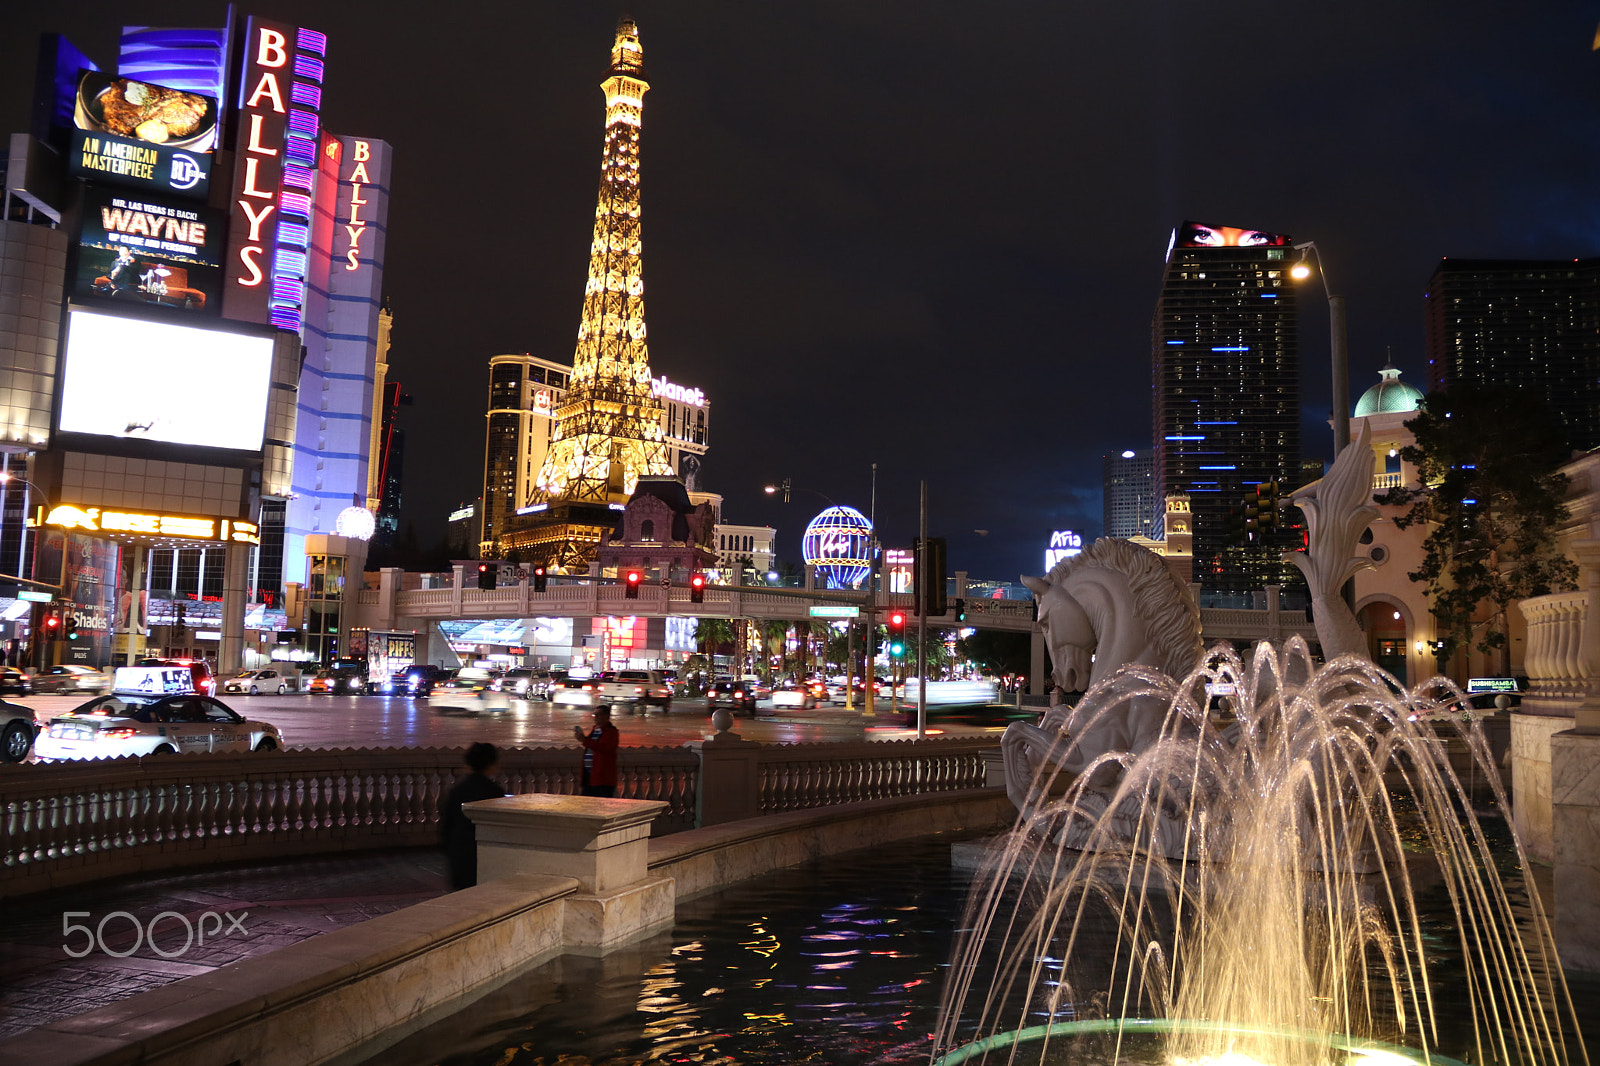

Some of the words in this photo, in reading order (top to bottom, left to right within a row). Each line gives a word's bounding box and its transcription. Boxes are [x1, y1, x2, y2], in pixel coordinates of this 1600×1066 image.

[82, 137, 100, 154] AN
[103, 141, 158, 165] AMERICAN
[82, 152, 154, 180] MASTERPIECE
[171, 160, 192, 182] BLT
[112, 198, 127, 208] MR.
[128, 201, 142, 211] LAS
[143, 204, 167, 216] VEGAS
[167, 208, 175, 217] IS
[177, 211, 198, 220] BACK!
[101, 206, 207, 247] WAYNE
[160, 241, 198, 255] PERSONAL
[651, 376, 704, 407] planet
[1050, 530, 1082, 548] Aria
[73, 611, 108, 630] Shades
